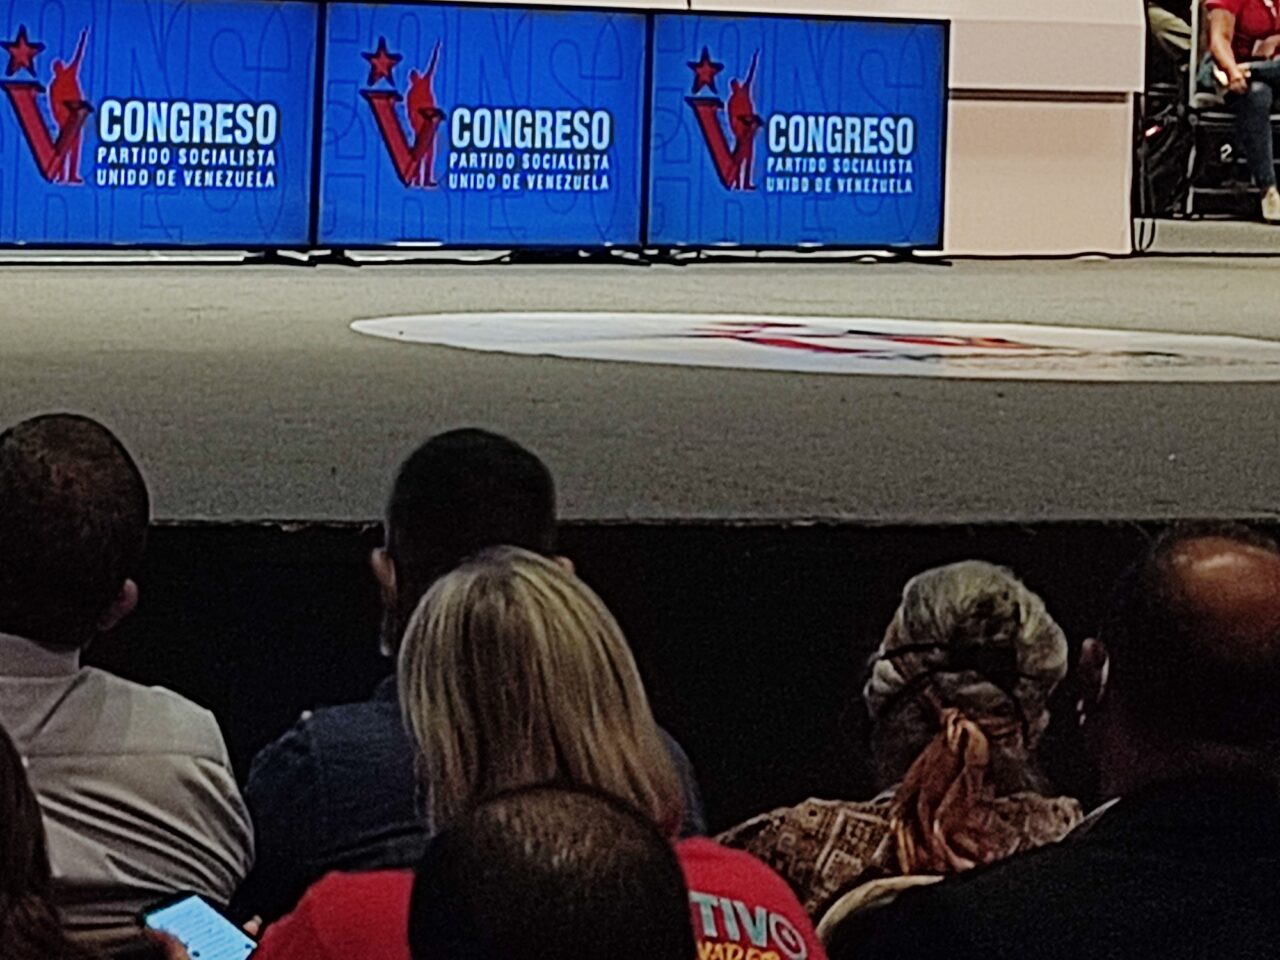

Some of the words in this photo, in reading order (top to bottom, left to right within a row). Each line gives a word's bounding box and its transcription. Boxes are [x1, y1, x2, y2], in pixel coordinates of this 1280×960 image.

[99, 99, 277, 145] CONGRESO
[451, 107, 611, 150] CONGRESO
[769, 114, 914, 155] CONGRESO
[97, 146, 171, 165] PARTIDO
[178, 147, 276, 167] SOCIALISTA
[449, 152, 515, 170] PARTIDO
[522, 153, 610, 170] SOCIALISTA
[767, 156, 827, 173] PARTIDO
[833, 157, 913, 174] SOCIALISTA
[96, 168, 148, 187] UNIDO
[156, 169, 176, 187] DE
[183, 170, 276, 188] VENEZUELA
[449, 173, 496, 190] UNIDO
[502, 173, 521, 190] DE
[526, 173, 609, 190] VENEZUELA
[766, 177, 810, 193] UNIDO
[815, 178, 832, 193] DE
[837, 177, 913, 194] VENEZUELA
